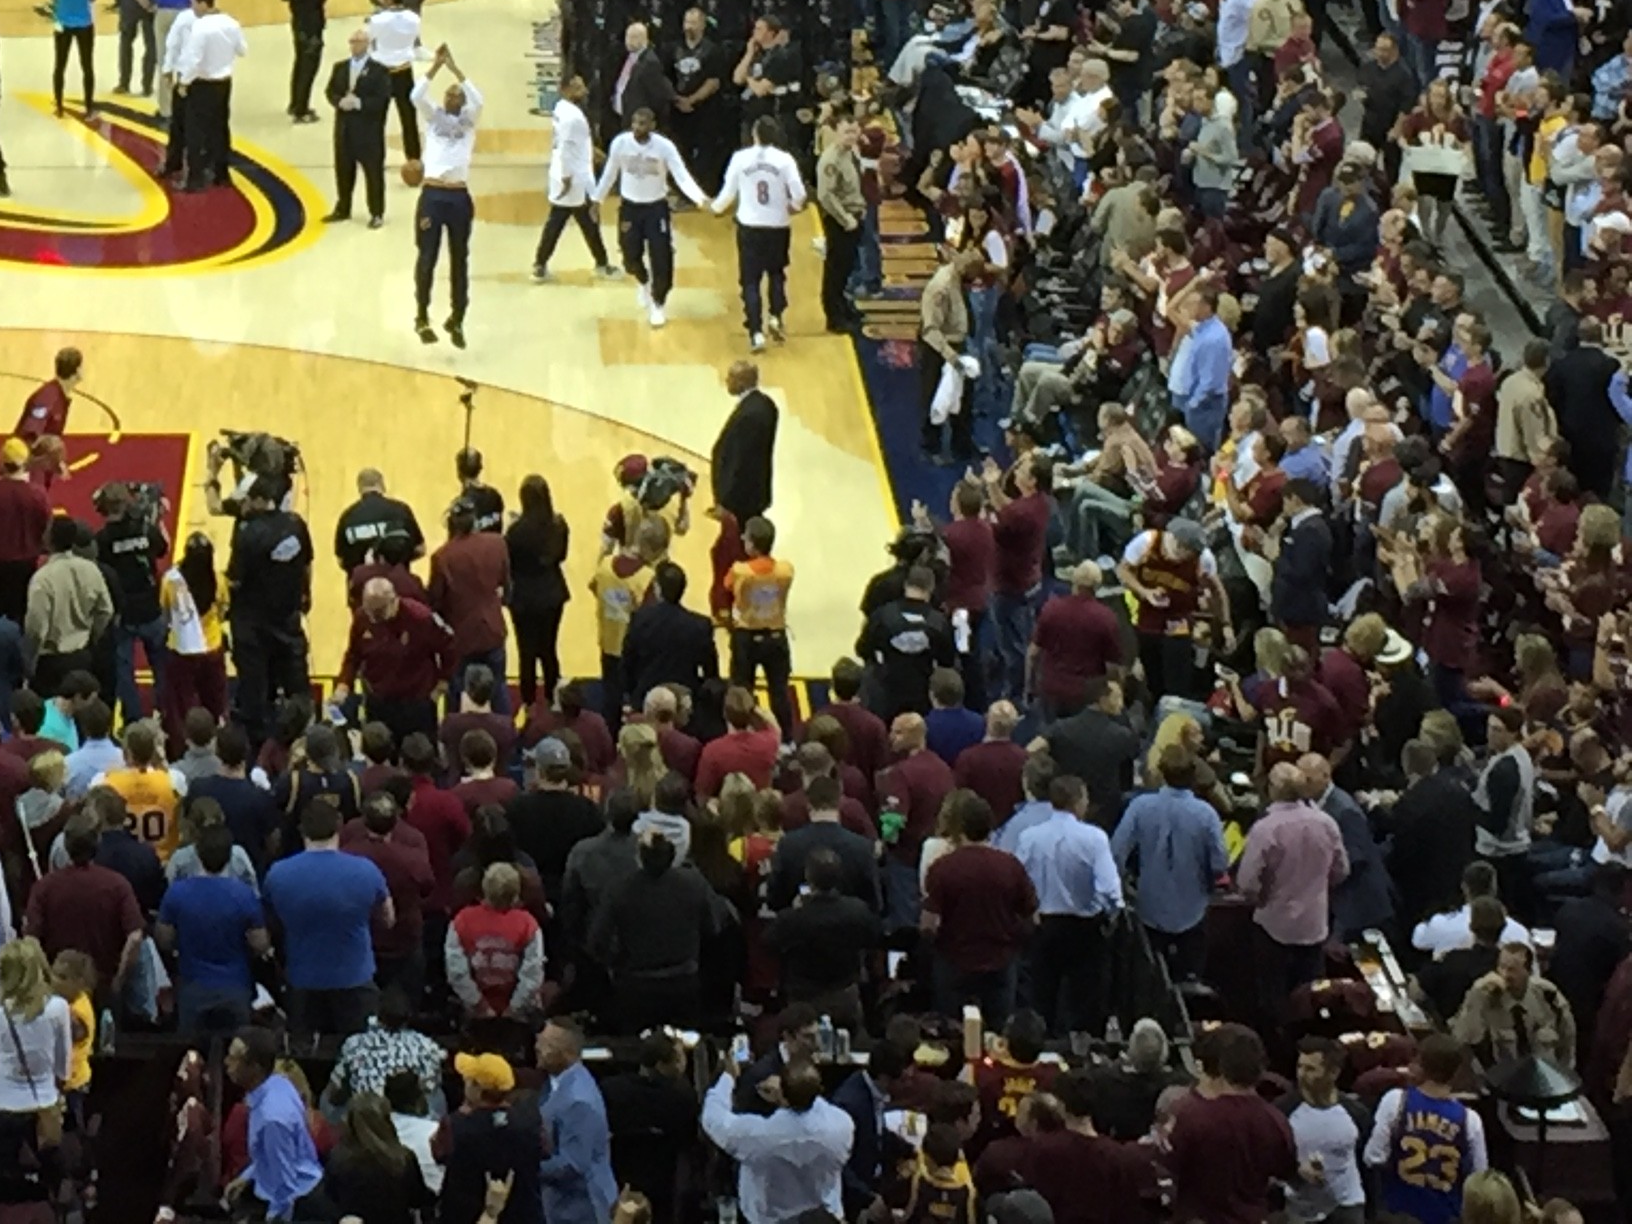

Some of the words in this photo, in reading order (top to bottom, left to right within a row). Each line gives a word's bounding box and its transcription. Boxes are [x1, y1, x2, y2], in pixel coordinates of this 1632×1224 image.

[757, 180, 769, 205] 8
[1405, 1109, 1461, 1142] JAMES
[1397, 1135, 1462, 1192] 23
